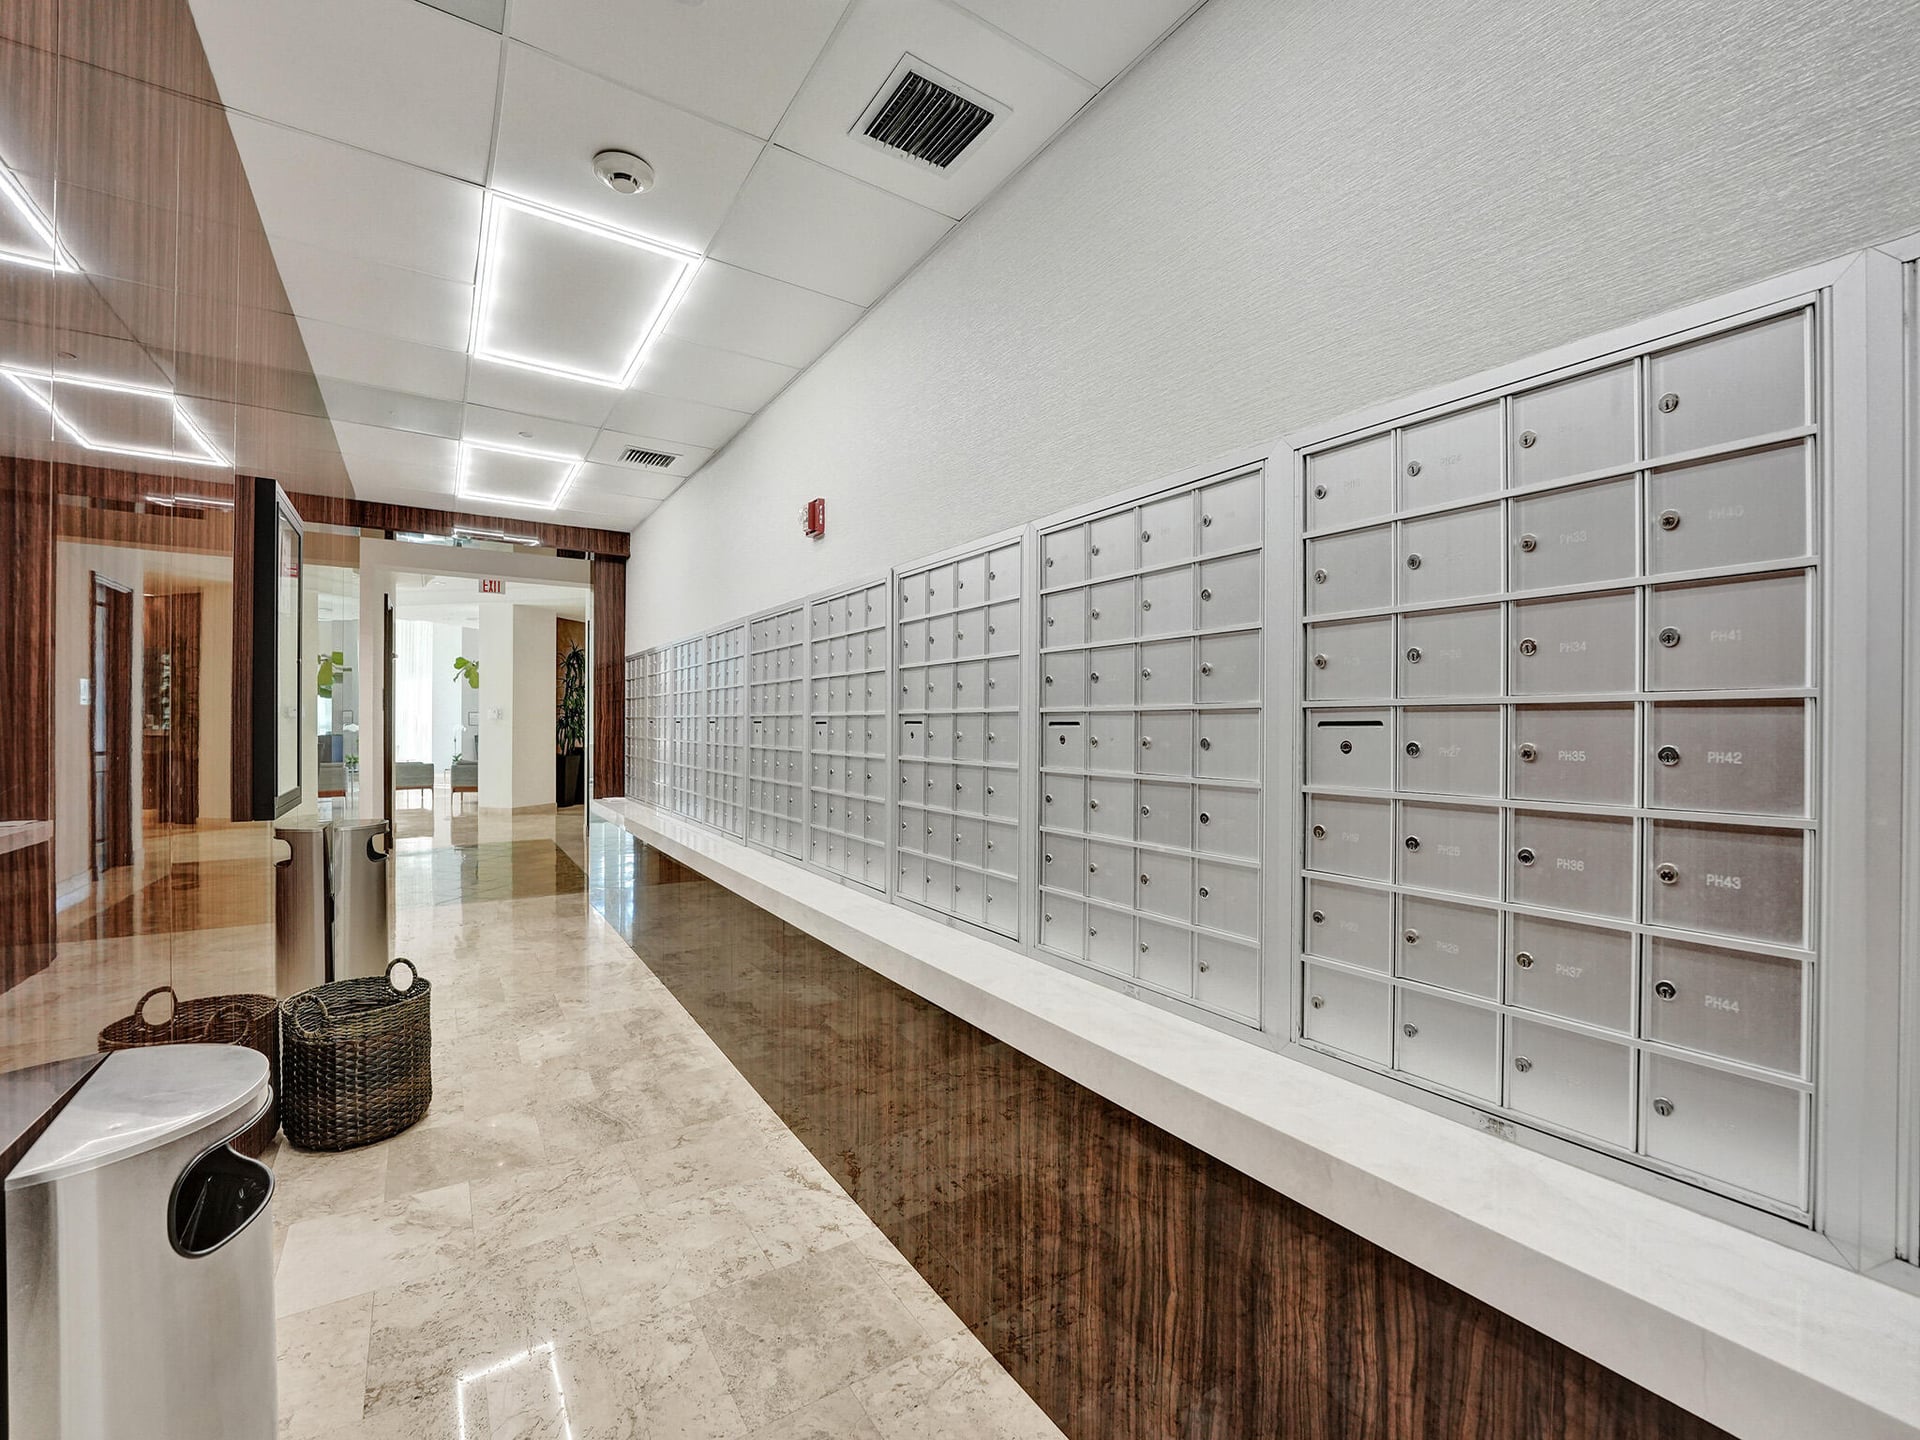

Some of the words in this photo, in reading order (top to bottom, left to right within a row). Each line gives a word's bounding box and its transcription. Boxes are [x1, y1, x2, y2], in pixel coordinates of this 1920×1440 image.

[1710, 628, 1743, 642] PH41
[1559, 640, 1588, 654] PH34
[1558, 749, 1587, 763] PH35
[1707, 750, 1743, 766] PH42
[1556, 857, 1585, 872] PH36
[1706, 872, 1742, 890] PH43
[1555, 962, 1583, 978] PH37
[1704, 994, 1740, 1014] PH44
